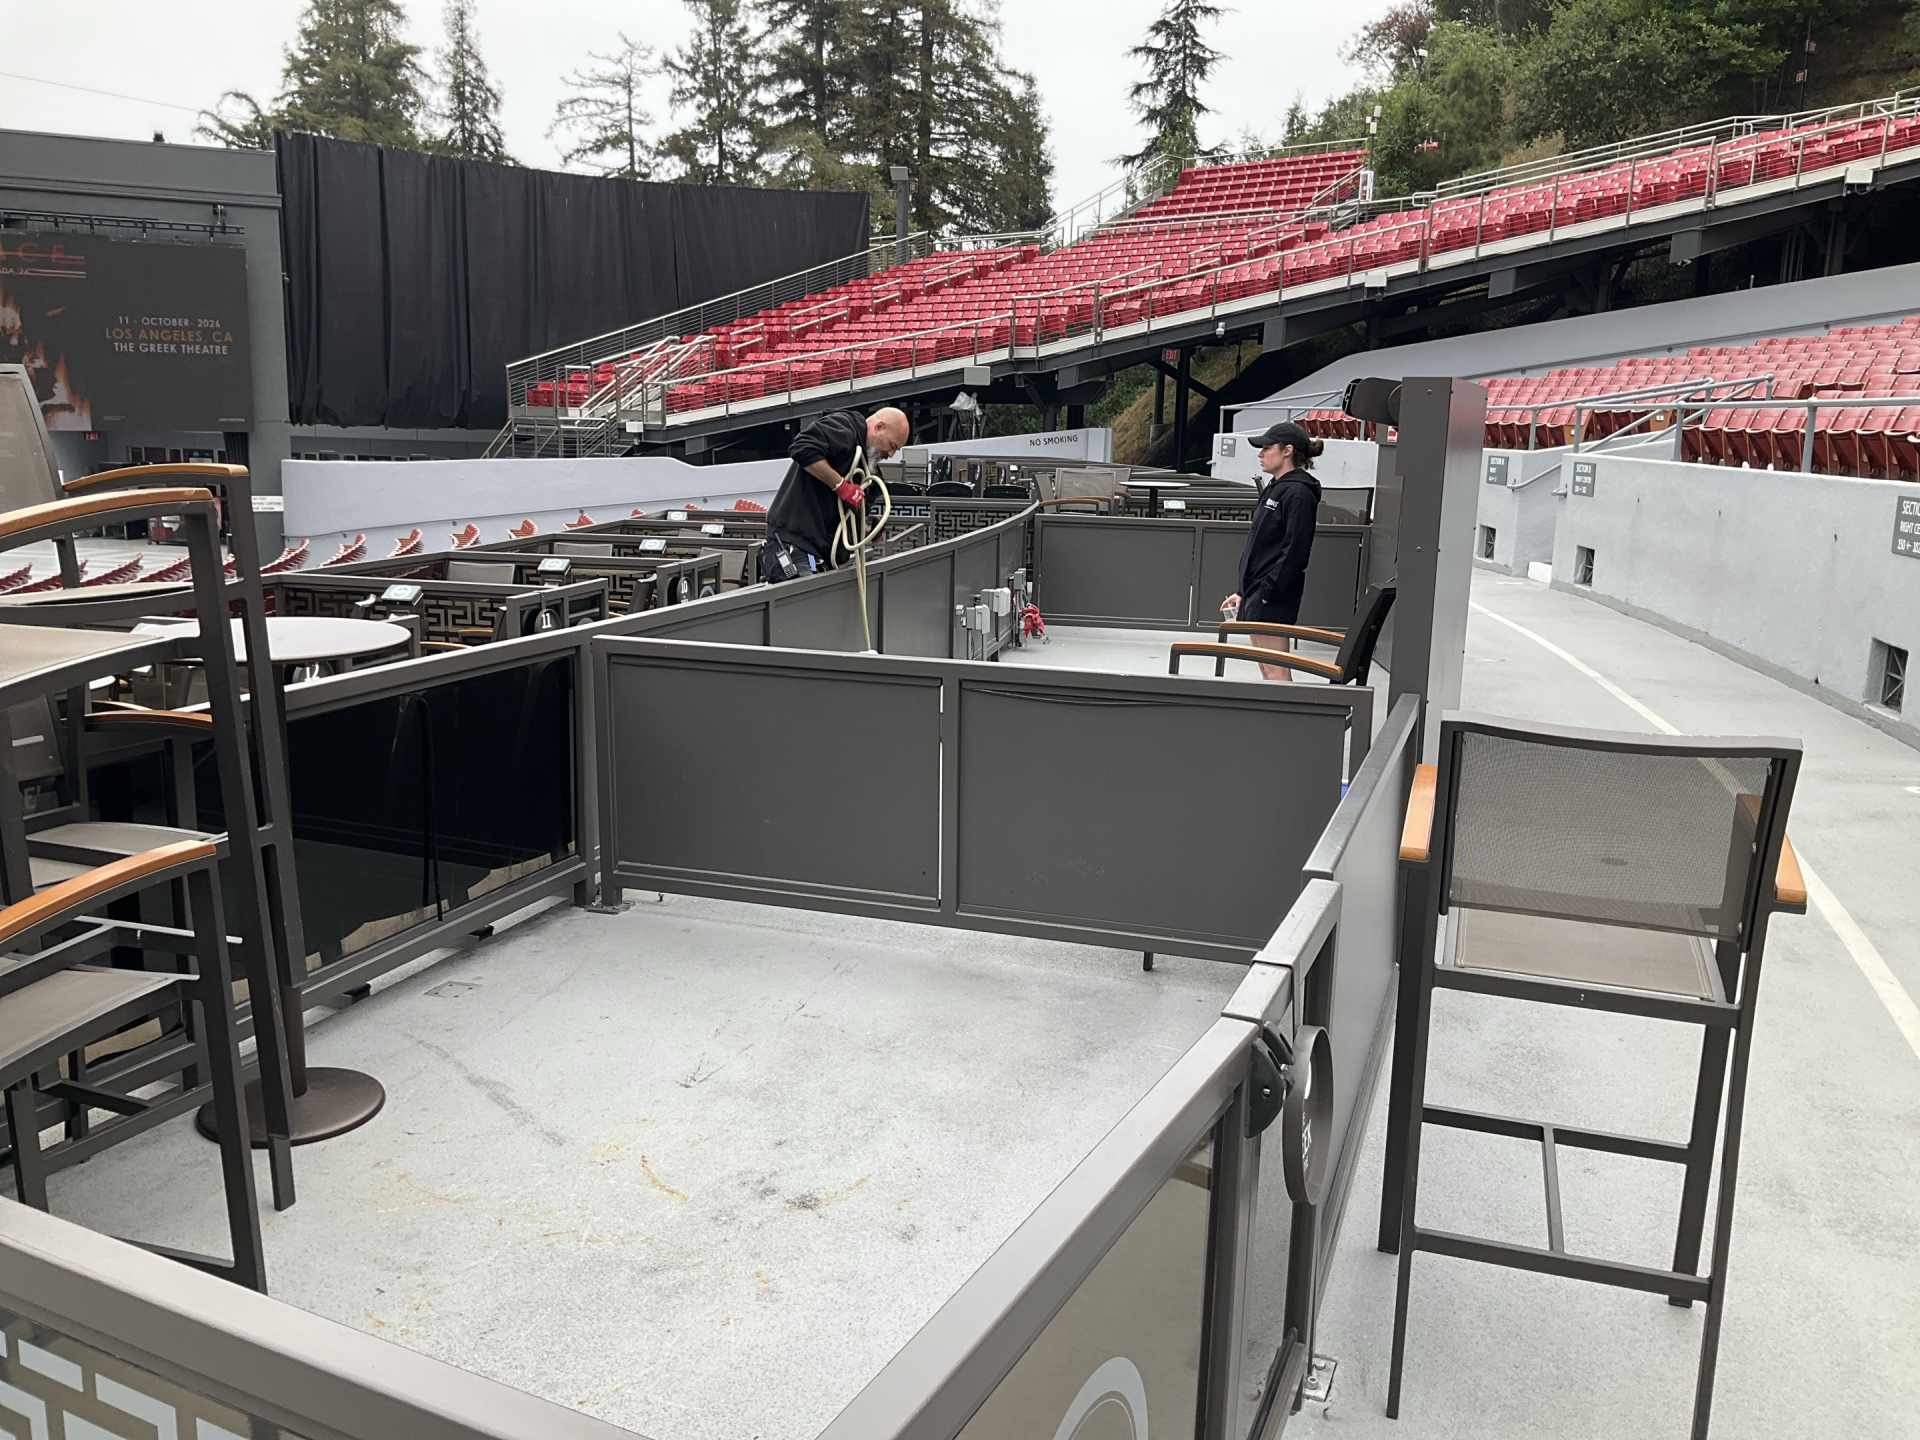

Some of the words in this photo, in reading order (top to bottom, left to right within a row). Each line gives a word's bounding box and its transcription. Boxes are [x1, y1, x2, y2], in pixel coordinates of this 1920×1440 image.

[118, 316, 128, 324] 11
[198, 319, 220, 328] 2026
[105, 328, 132, 340] LOS
[212, 331, 233, 342] CA
[114, 342, 134, 352] THE
[138, 343, 177, 353] GREEK
[180, 344, 228, 354] THEATRE
[1166, 350, 1177, 360] EXIT
[1043, 435, 1078, 446] SMOKING
[1900, 521, 1914, 534] RIGHT
[1897, 539, 1906, 550] 150
[681, 580, 688, 594] 10
[541, 612, 552, 629] 11
[305, 662, 320, 682] 12
